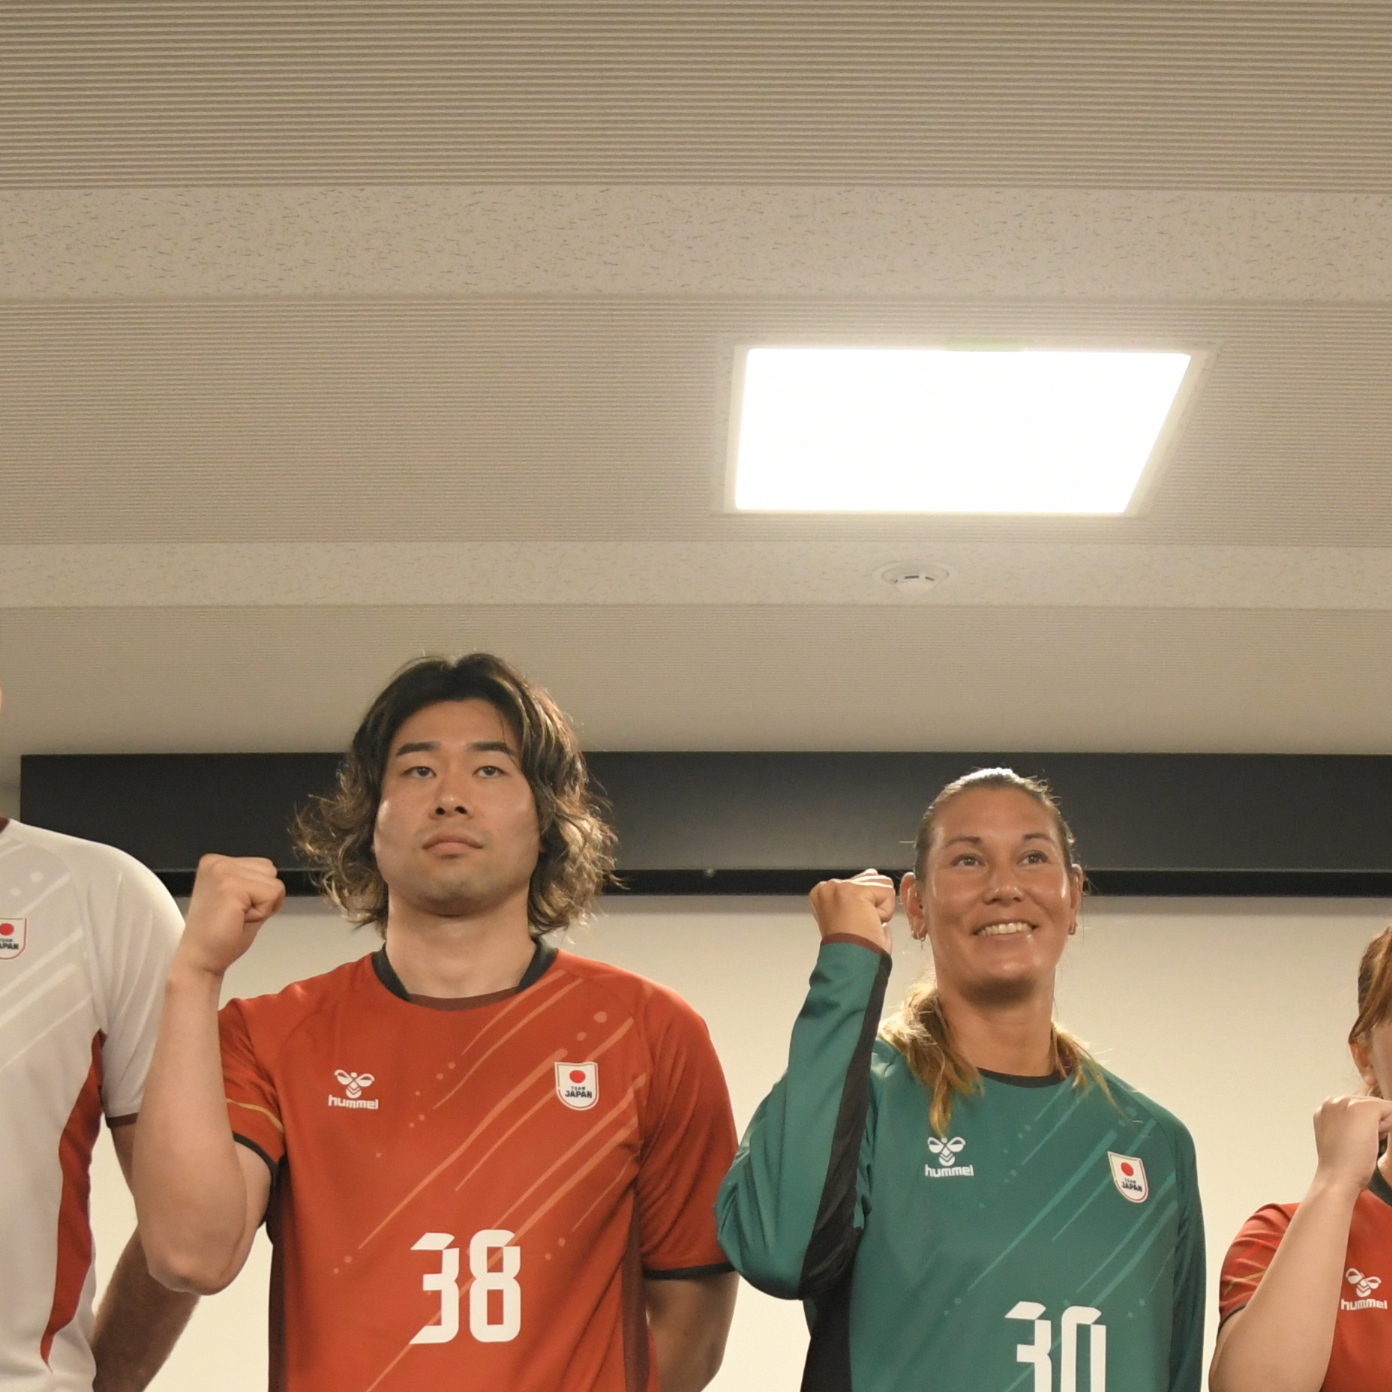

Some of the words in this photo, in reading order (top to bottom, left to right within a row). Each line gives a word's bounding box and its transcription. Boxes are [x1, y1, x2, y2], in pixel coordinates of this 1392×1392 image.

[565, 1090, 593, 1098] JAPAN
[328, 1094, 379, 1110] hummel
[924, 1163, 974, 1178] hummel
[1121, 1181, 1143, 1192] JAPAN
[409, 1229, 521, 1344] 38
[1340, 1298, 1388, 1311] hummel
